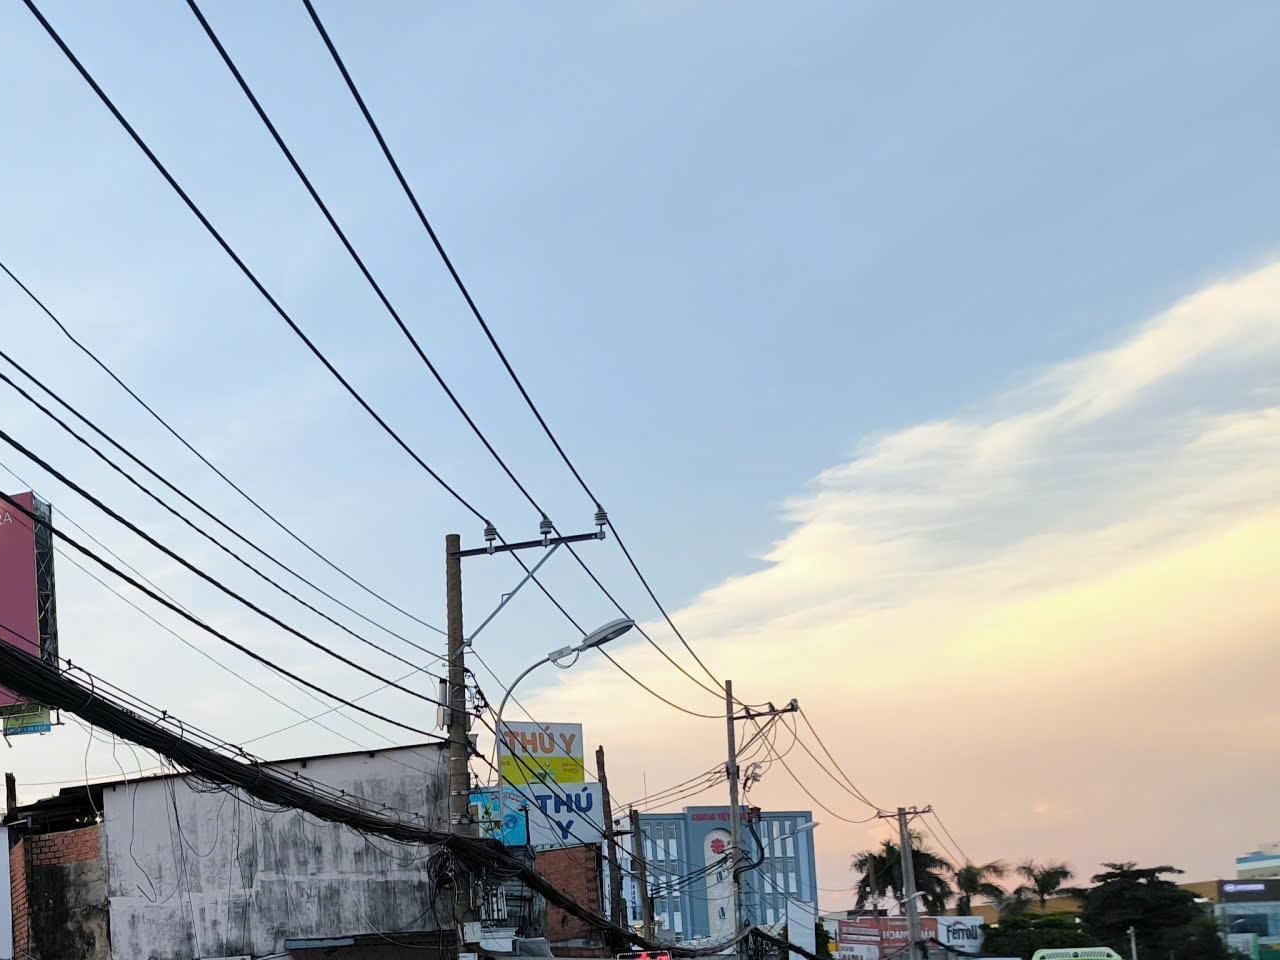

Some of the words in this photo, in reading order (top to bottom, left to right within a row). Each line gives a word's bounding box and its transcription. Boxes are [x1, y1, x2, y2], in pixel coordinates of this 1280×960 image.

[504, 725, 555, 754] THÚ
[559, 732, 576, 754] Y
[535, 786, 593, 814] THÚ
[556, 819, 574, 840] Y
